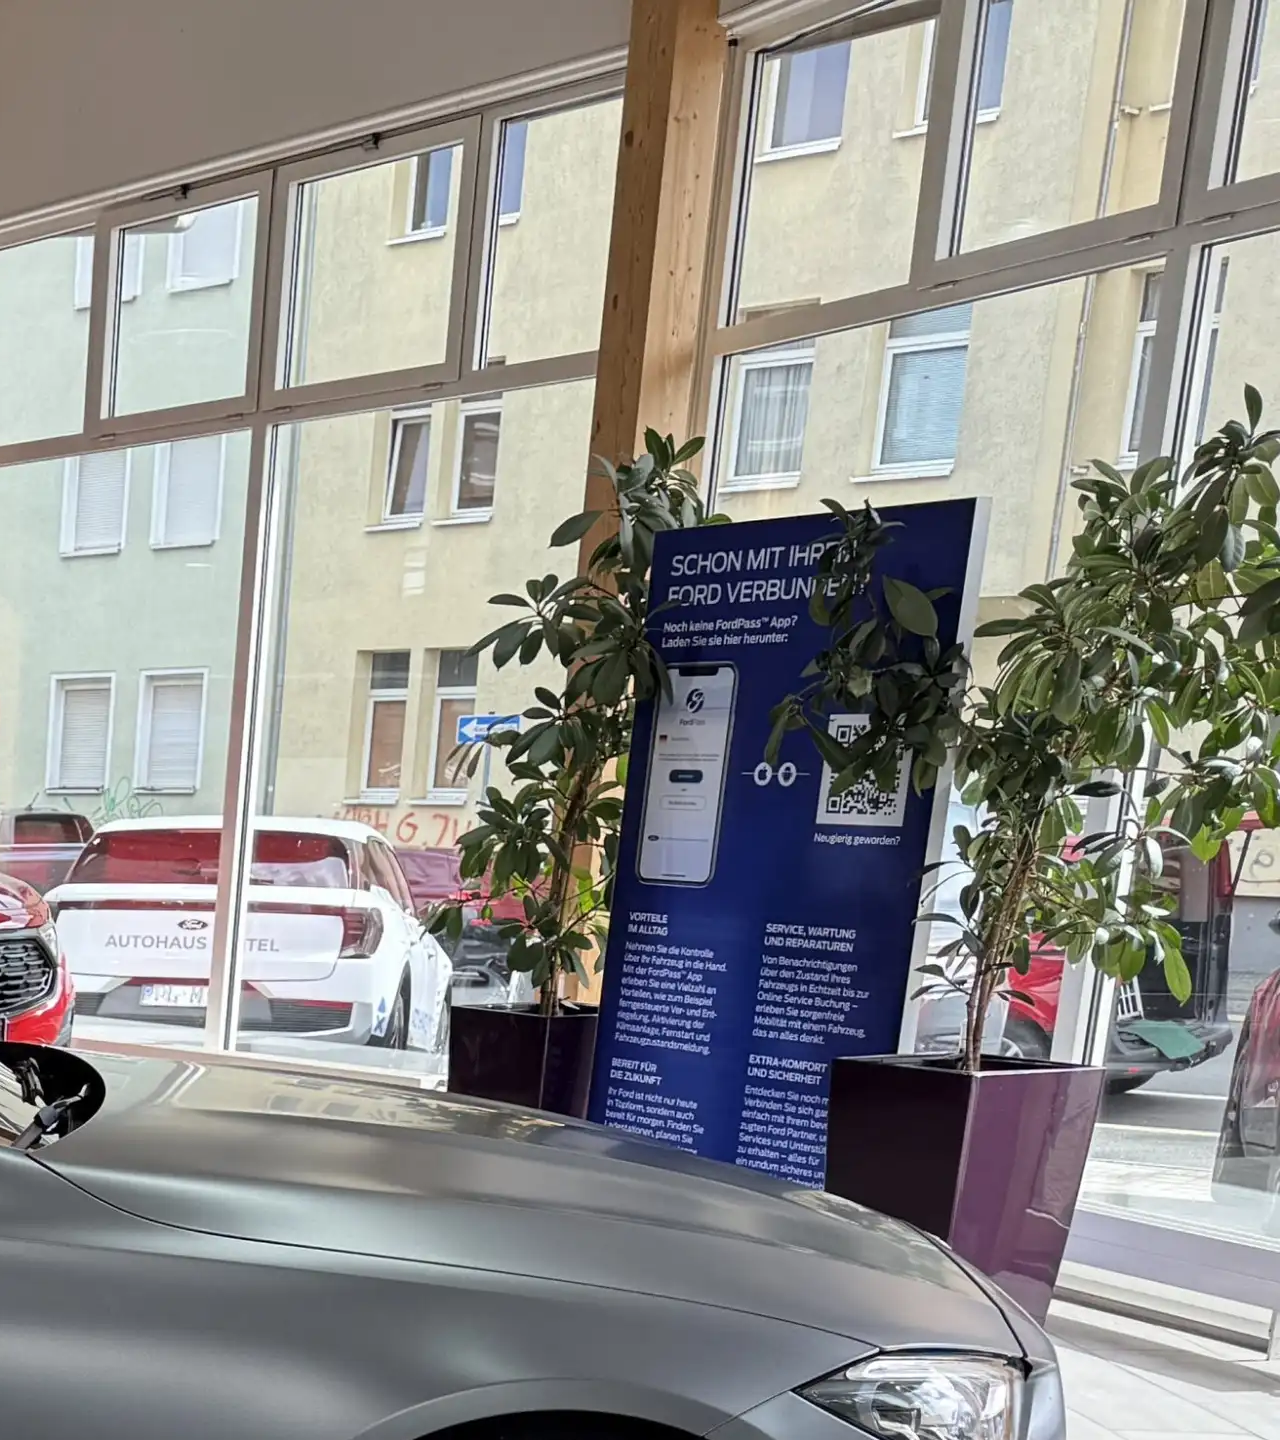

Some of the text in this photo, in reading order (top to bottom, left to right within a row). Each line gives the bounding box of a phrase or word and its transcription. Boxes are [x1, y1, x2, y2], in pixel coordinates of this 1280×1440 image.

[670, 539, 858, 576] SCHON MIT IHR
[668, 583, 722, 607] FORD
[663, 621, 689, 633] Noch
[689, 620, 715, 632] keine
[770, 615, 799, 629] App?
[661, 632, 789, 649] Laden Sie sie hier herunter:
[814, 832, 901, 846] Neugierig geworden?
[629, 911, 668, 924] VORTEILE
[627, 923, 668, 937] IM ALLTAG
[765, 923, 856, 940] SERVICE, WARTUNG
[105, 934, 280, 952] AUTOHAUS TEL
[763, 936, 854, 953] UND REPARATUREN
[762, 954, 858, 973] Von Benachrichtigungen
[760, 966, 851, 985] über den Zustand Ihres
[758, 979, 870, 999] Fahrzeugs in Echtzeit bis zur
[757, 991, 783, 1003] Online
[783, 993, 814, 1006] Service
[814, 997, 851, 1012] Buchung
[755, 1003, 845, 1022] erleben Sie sorgenfreie
[754, 1015, 787, 1028] Mobilität
[788, 1020, 802, 1030] mit
[802, 1022, 827, 1033] einem
[752, 1027, 825, 1045] das an alles denkt.
[611, 1057, 658, 1073] BEREIT FÜR
[748, 1054, 828, 1073] EXTRA-KOMFORT
[610, 1069, 662, 1086] DIE ZUKUNFT
[747, 1066, 822, 1085] UND SICHERHEIT
[745, 1085, 786, 1099] Entdecken
[786, 1091, 799, 1101] Sie
[800, 1093, 820, 1104] noch
[744, 1097, 782, 1111] Verbinden
[783, 1103, 796, 1113] Sie
[797, 1106, 814, 1117] sich
[741, 1109, 771, 1122] einfach
[771, 1114, 785, 1124] mit
[785, 1116, 809, 1127] Ihrem
[738, 1132, 771, 1146] Services
[772, 1138, 788, 1148] und
[740, 1122, 766, 1133] zugten
[767, 1125, 786, 1136] Ford
[786, 1127, 818, 1142] Partner,
[737, 1145, 747, 1154] zu
[747, 1147, 780, 1159] erhalten
[787, 1153, 807, 1164] alles
[808, 1155, 820, 1166] für
[735, 1156, 748, 1166] ein
[748, 1159, 779, 1171] rundum
[779, 1163, 813, 1177] sicheres
